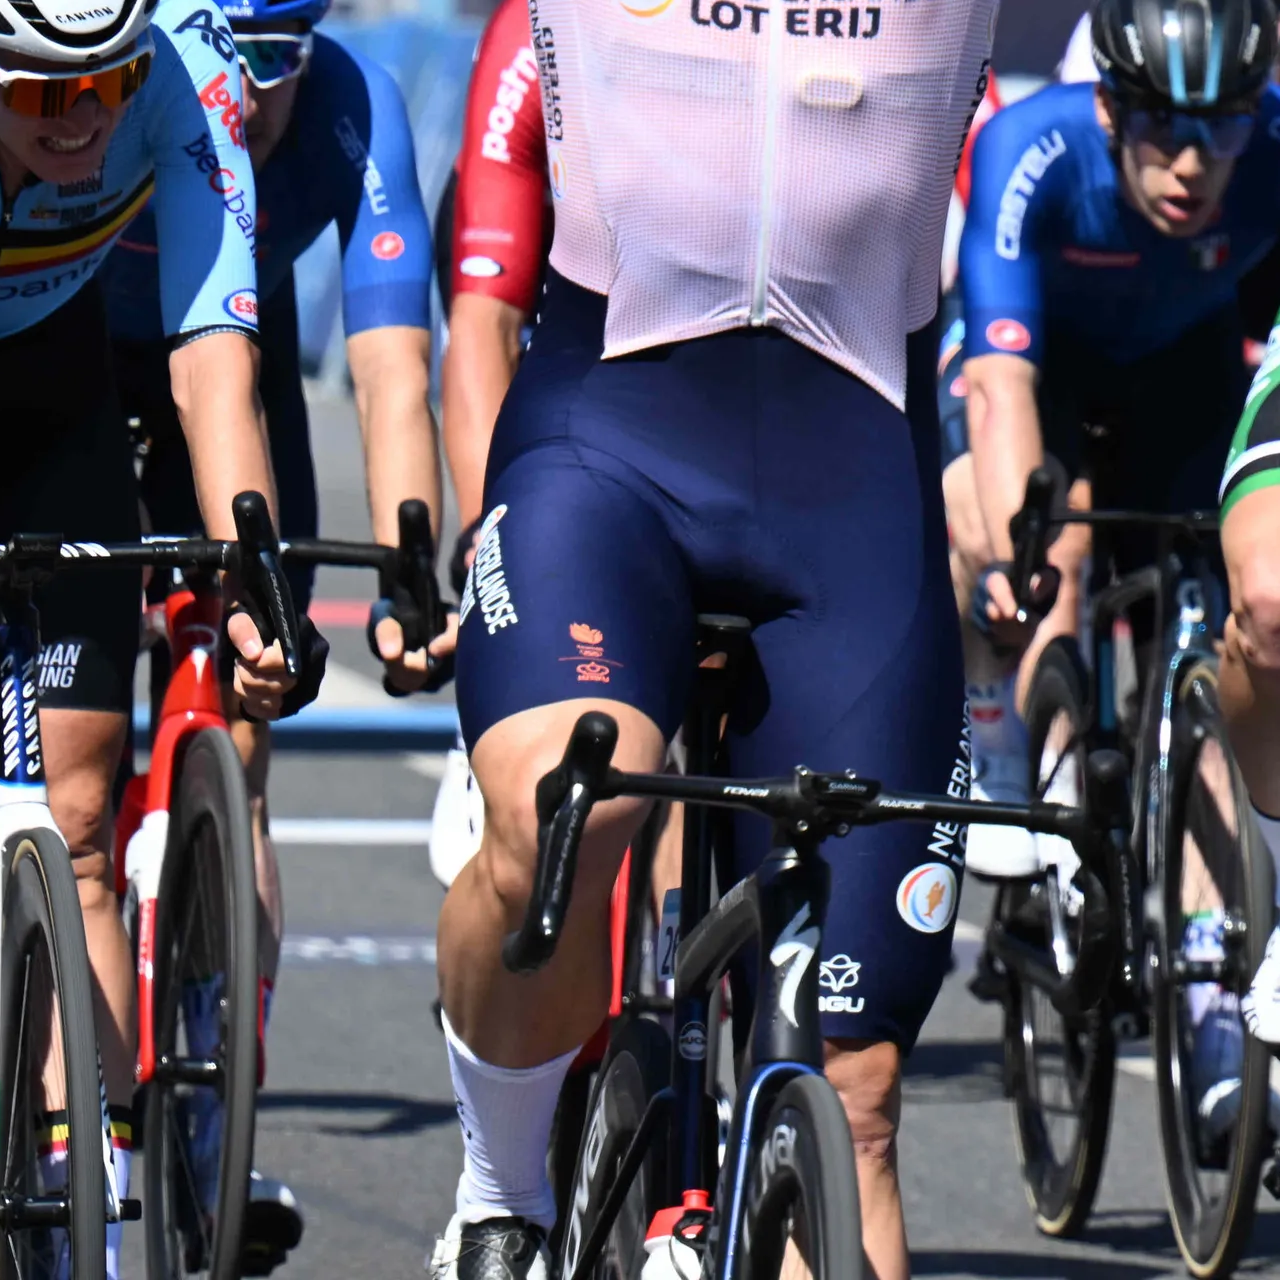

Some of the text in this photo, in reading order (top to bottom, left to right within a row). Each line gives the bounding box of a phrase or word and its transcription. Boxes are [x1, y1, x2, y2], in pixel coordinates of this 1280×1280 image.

[54, 5, 115, 25] CANYON
[828, 781, 868, 793] GARMIN
[878, 799, 926, 810] RAPIDE
